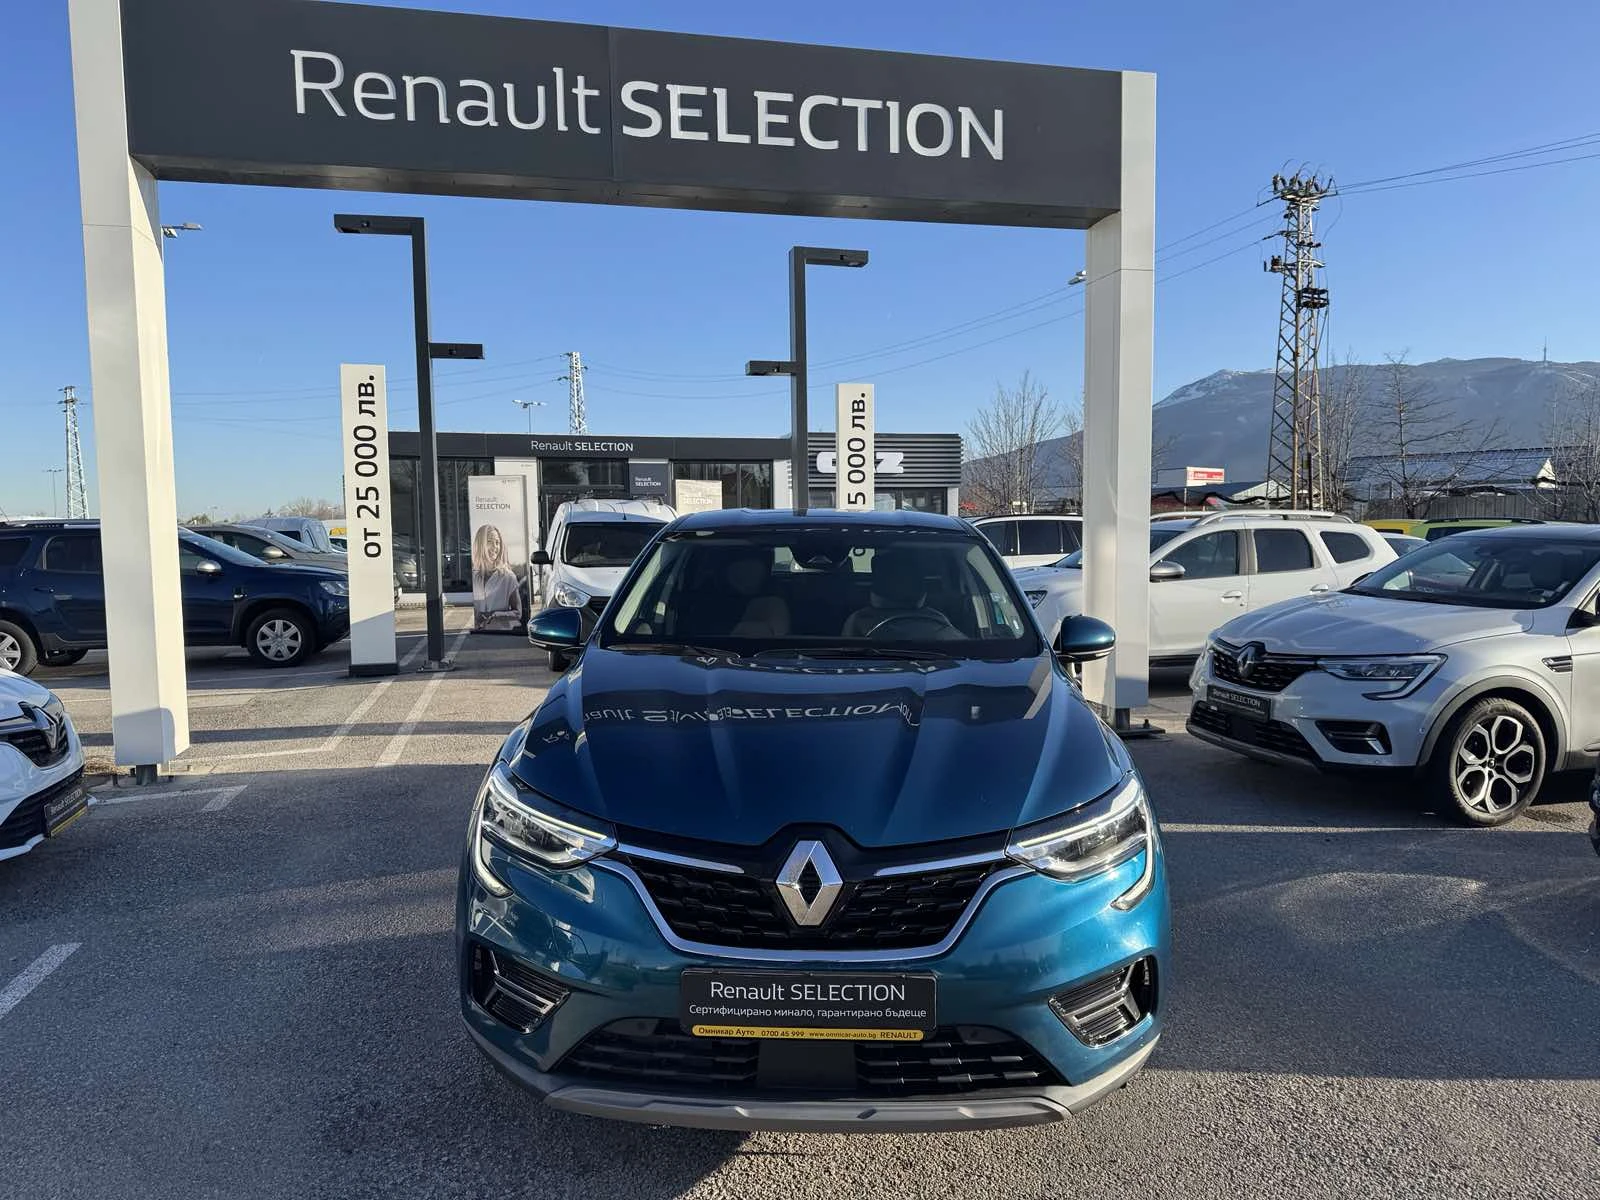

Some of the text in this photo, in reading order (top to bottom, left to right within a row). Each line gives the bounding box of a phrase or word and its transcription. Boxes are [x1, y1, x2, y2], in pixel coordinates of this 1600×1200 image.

[290, 49, 1004, 161] Renault SELECTION
[852, 392, 866, 431] лв.
[531, 440, 634, 452] Renault SELECTION
[847, 437, 866, 484] 000
[353, 375, 381, 558] от 25 000 лв.
[711, 981, 905, 1001] Renault SELECTION
[689, 1004, 927, 1019] Сертифицирано минало, гарантирано бъдеще
[698, 1027, 734, 1036] Омникар
[735, 1028, 755, 1036] Ауто
[880, 1031, 918, 1039] RENAULT
